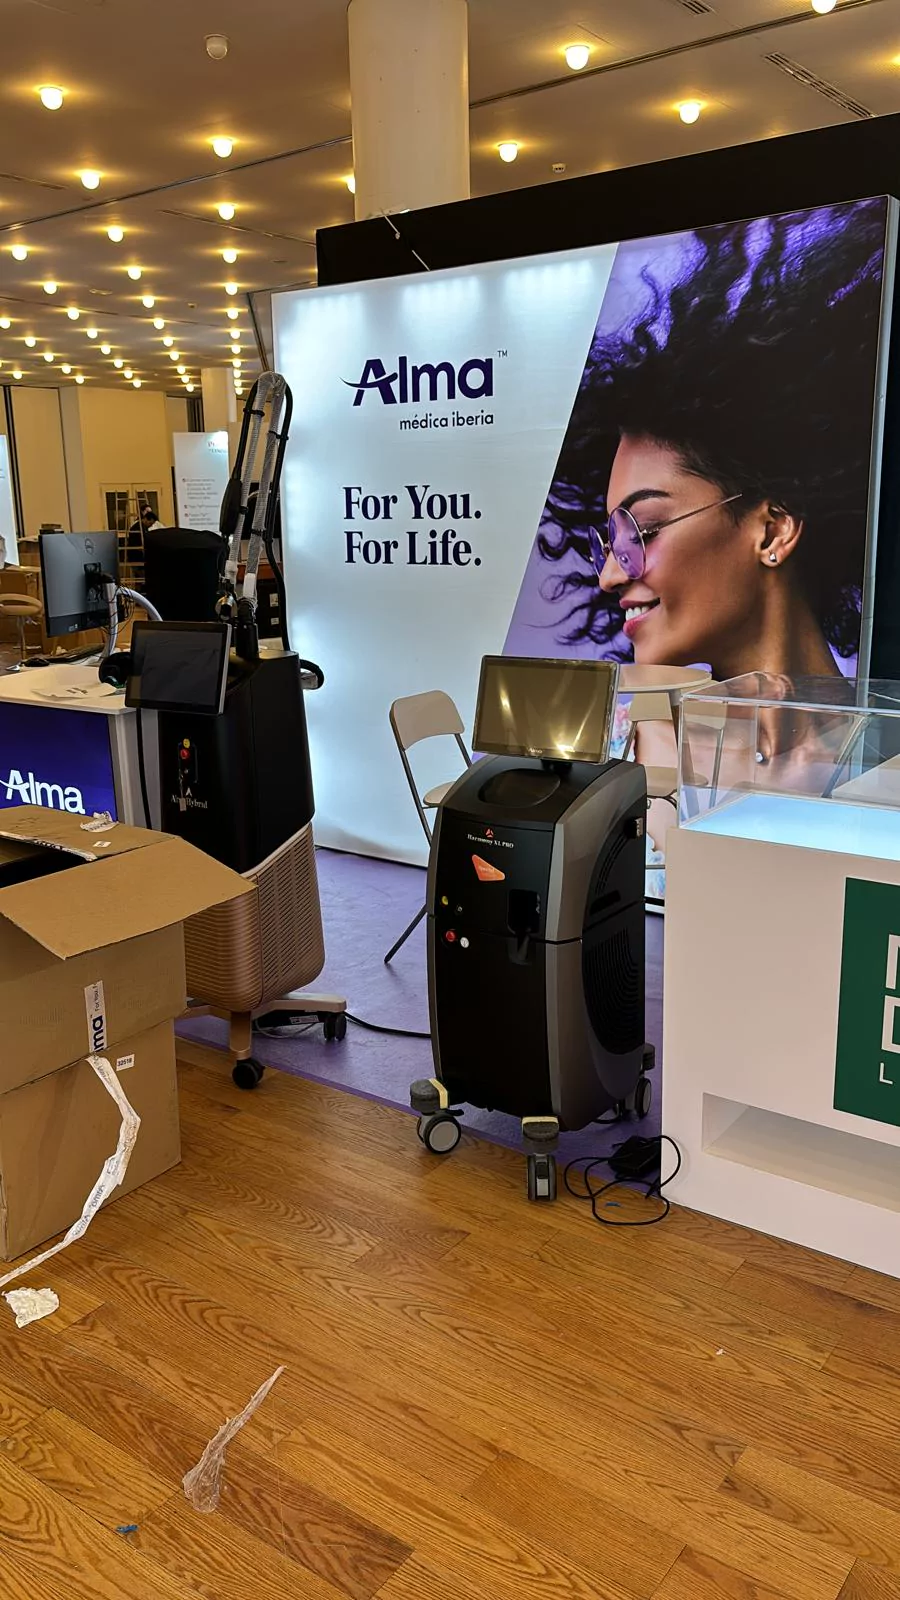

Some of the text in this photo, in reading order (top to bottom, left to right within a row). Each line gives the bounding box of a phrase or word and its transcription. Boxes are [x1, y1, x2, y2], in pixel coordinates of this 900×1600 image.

[340, 356, 493, 406] Alma
[400, 409, 494, 430] médica iberia
[343, 485, 482, 520] For You.
[344, 529, 482, 566] For Life.
[0, 769, 86, 815] Alma
[467, 833, 493, 846] Harmony
[92, 1015, 104, 1054] lma
